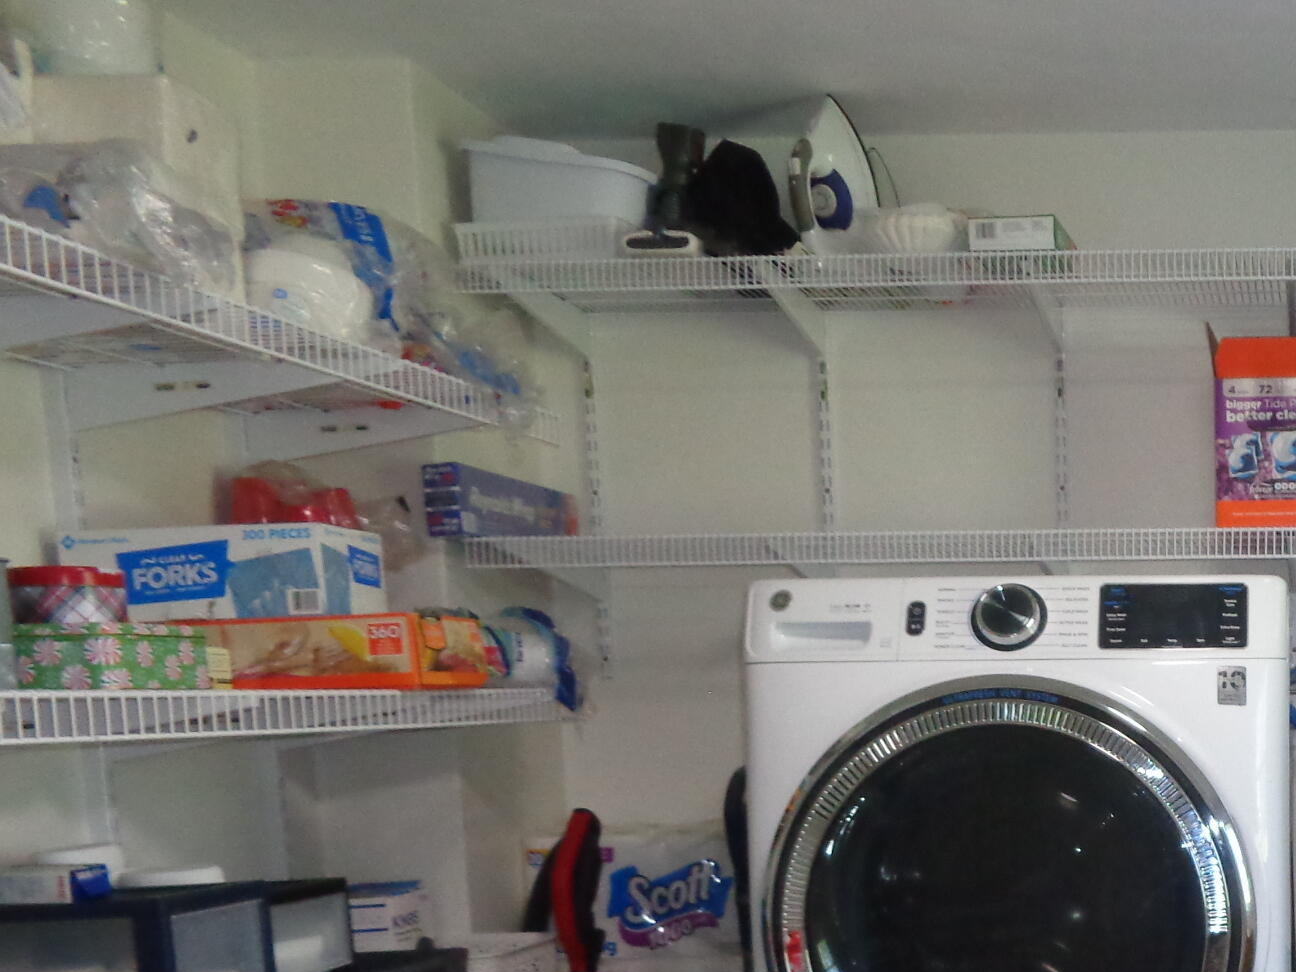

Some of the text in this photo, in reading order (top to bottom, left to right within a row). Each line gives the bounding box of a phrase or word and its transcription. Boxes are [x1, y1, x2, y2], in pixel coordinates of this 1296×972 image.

[1259, 384, 1273, 394] 72
[1225, 399, 1261, 411] bigger
[1264, 400, 1287, 409] Tide
[1225, 410, 1273, 423] better
[268, 528, 311, 539] PIECES
[131, 561, 219, 591] FORKS
[369, 626, 400, 639] 360
[625, 861, 715, 923] Scott
